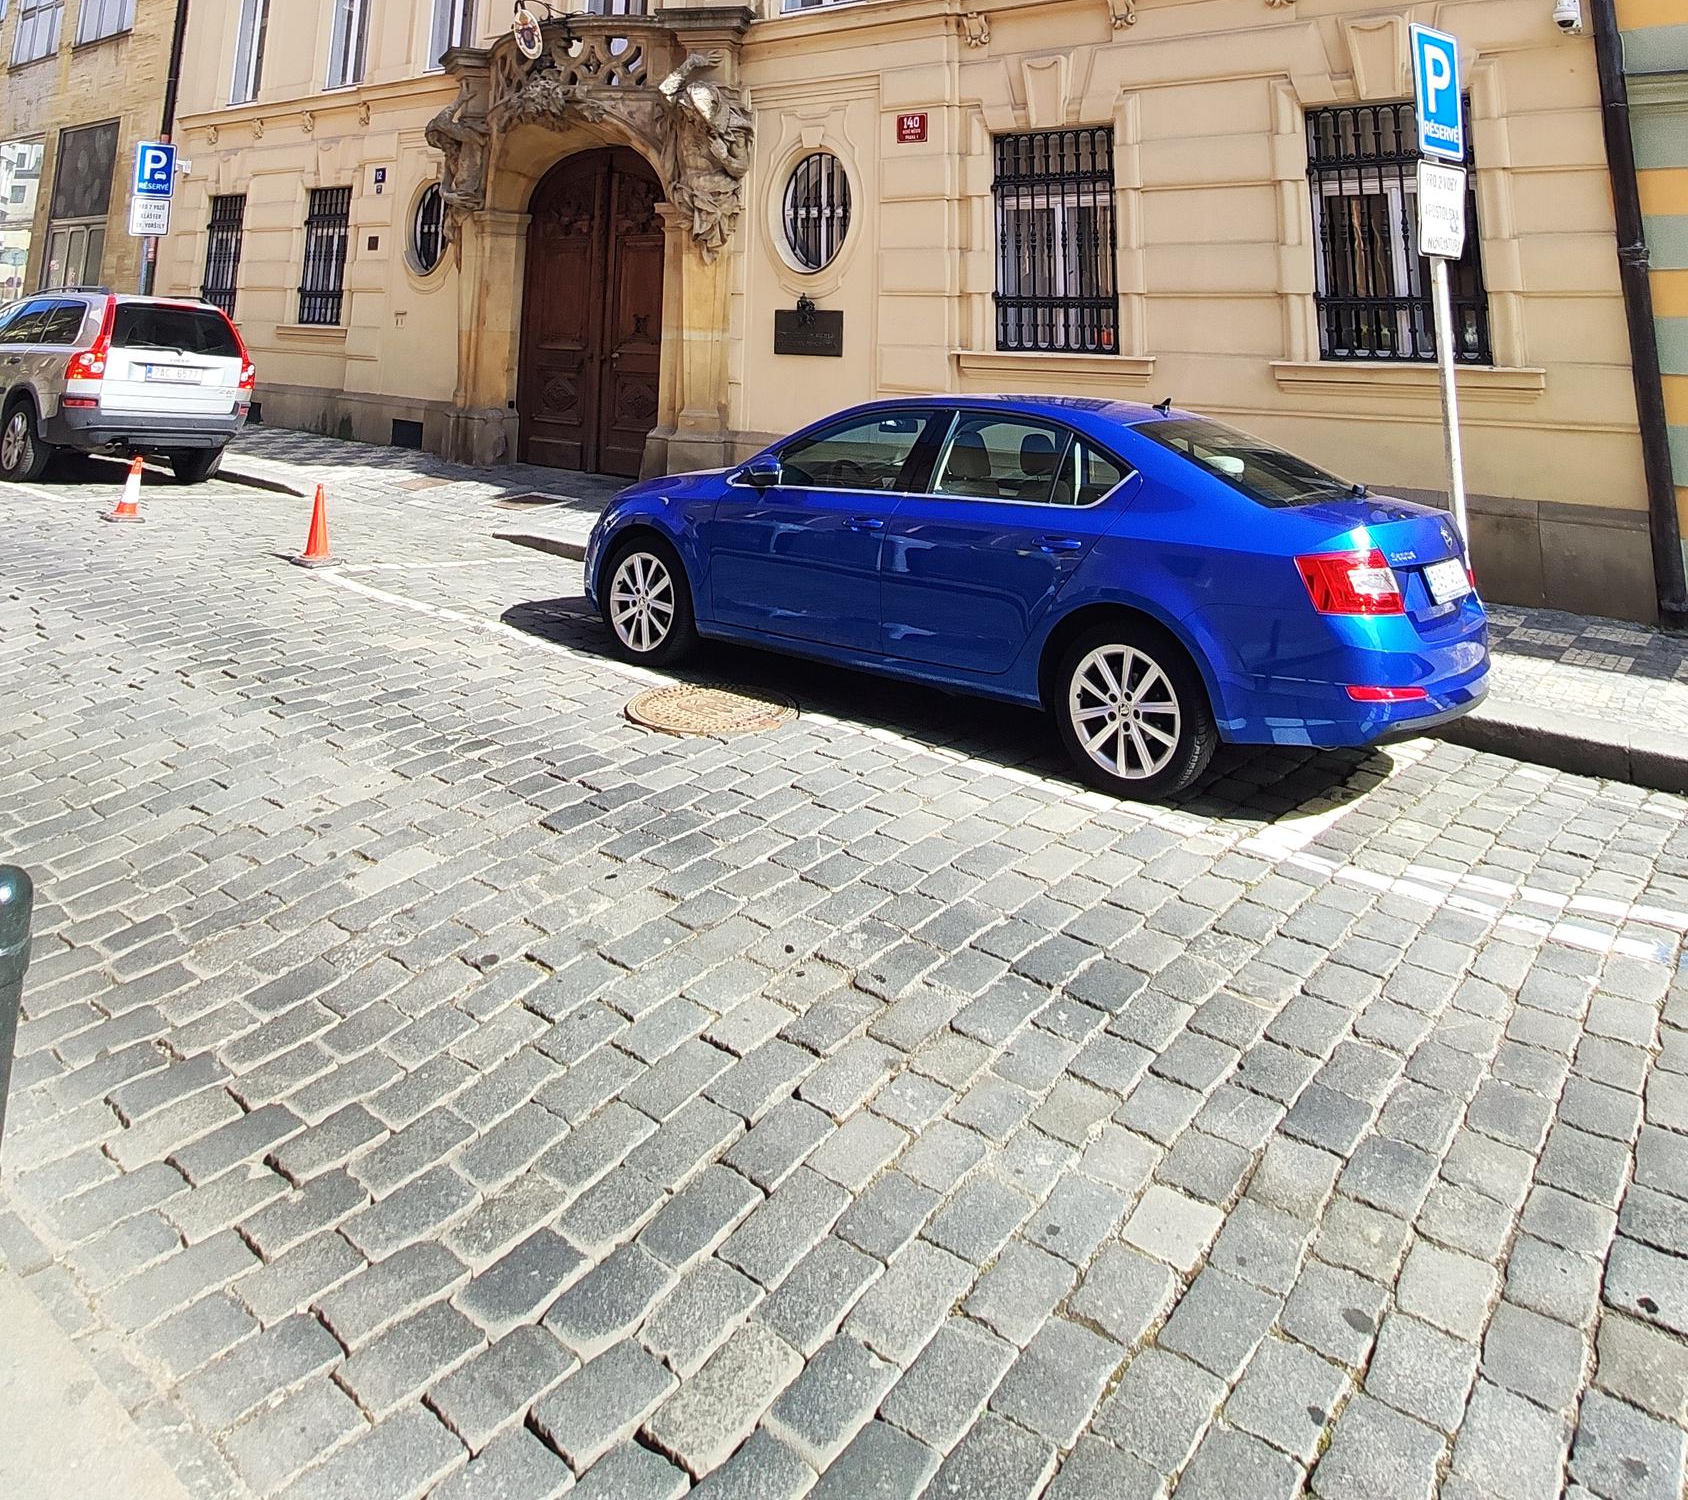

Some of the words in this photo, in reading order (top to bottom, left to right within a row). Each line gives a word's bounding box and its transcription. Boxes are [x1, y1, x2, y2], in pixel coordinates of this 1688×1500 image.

[1423, 43, 1450, 113] P
[903, 116, 920, 129] 140
[1424, 118, 1459, 144] RÉSERVÉ
[143, 149, 168, 179] P
[138, 181, 169, 191] RÉSERVÉ
